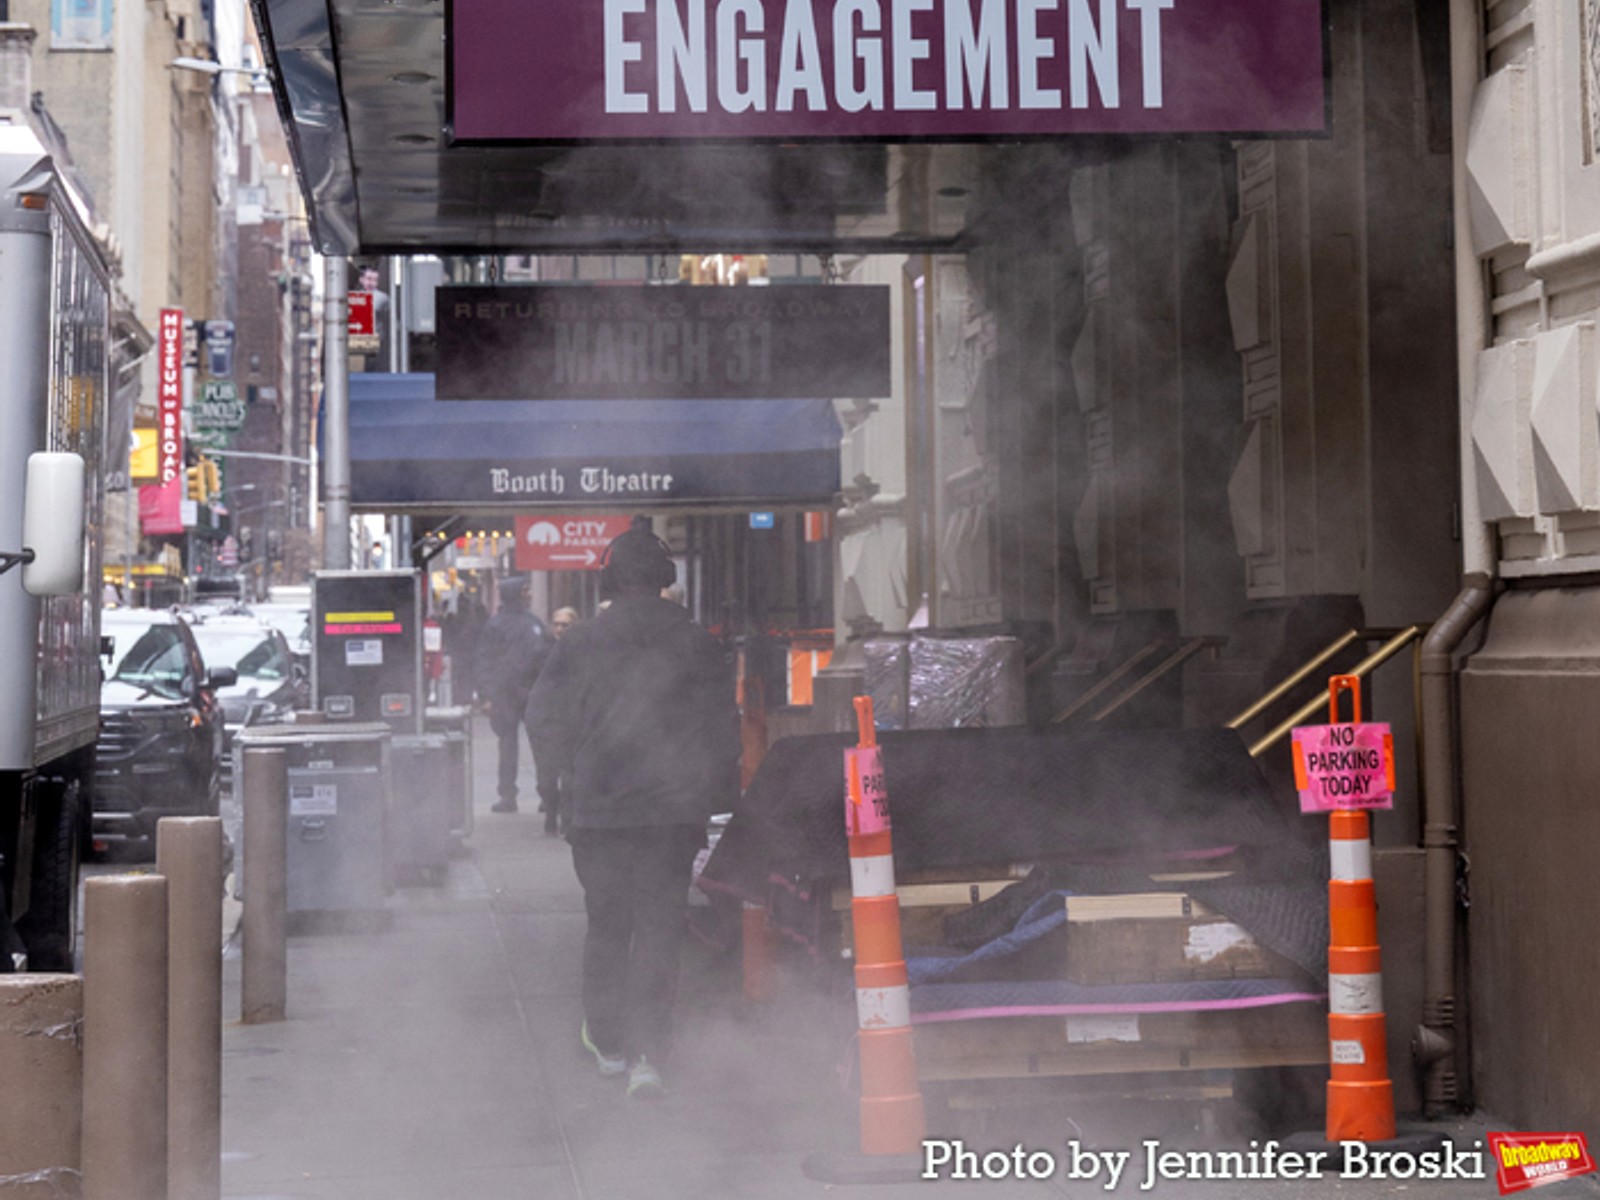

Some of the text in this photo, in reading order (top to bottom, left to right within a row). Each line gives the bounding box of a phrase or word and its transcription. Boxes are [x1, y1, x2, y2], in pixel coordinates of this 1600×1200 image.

[454, 301, 870, 320] RETURNING TO BROADWAY
[163, 314, 177, 396] MUSEUM
[554, 320, 773, 384] MARCH 31
[161, 413, 177, 488] BROAD
[489, 467, 674, 494] Booth Theatre
[562, 521, 608, 537] CITY
[563, 537, 614, 546] PARKIN
[1330, 726, 1355, 746] NO
[1307, 749, 1379, 772] PARKING
[1319, 775, 1372, 797] TODAY
